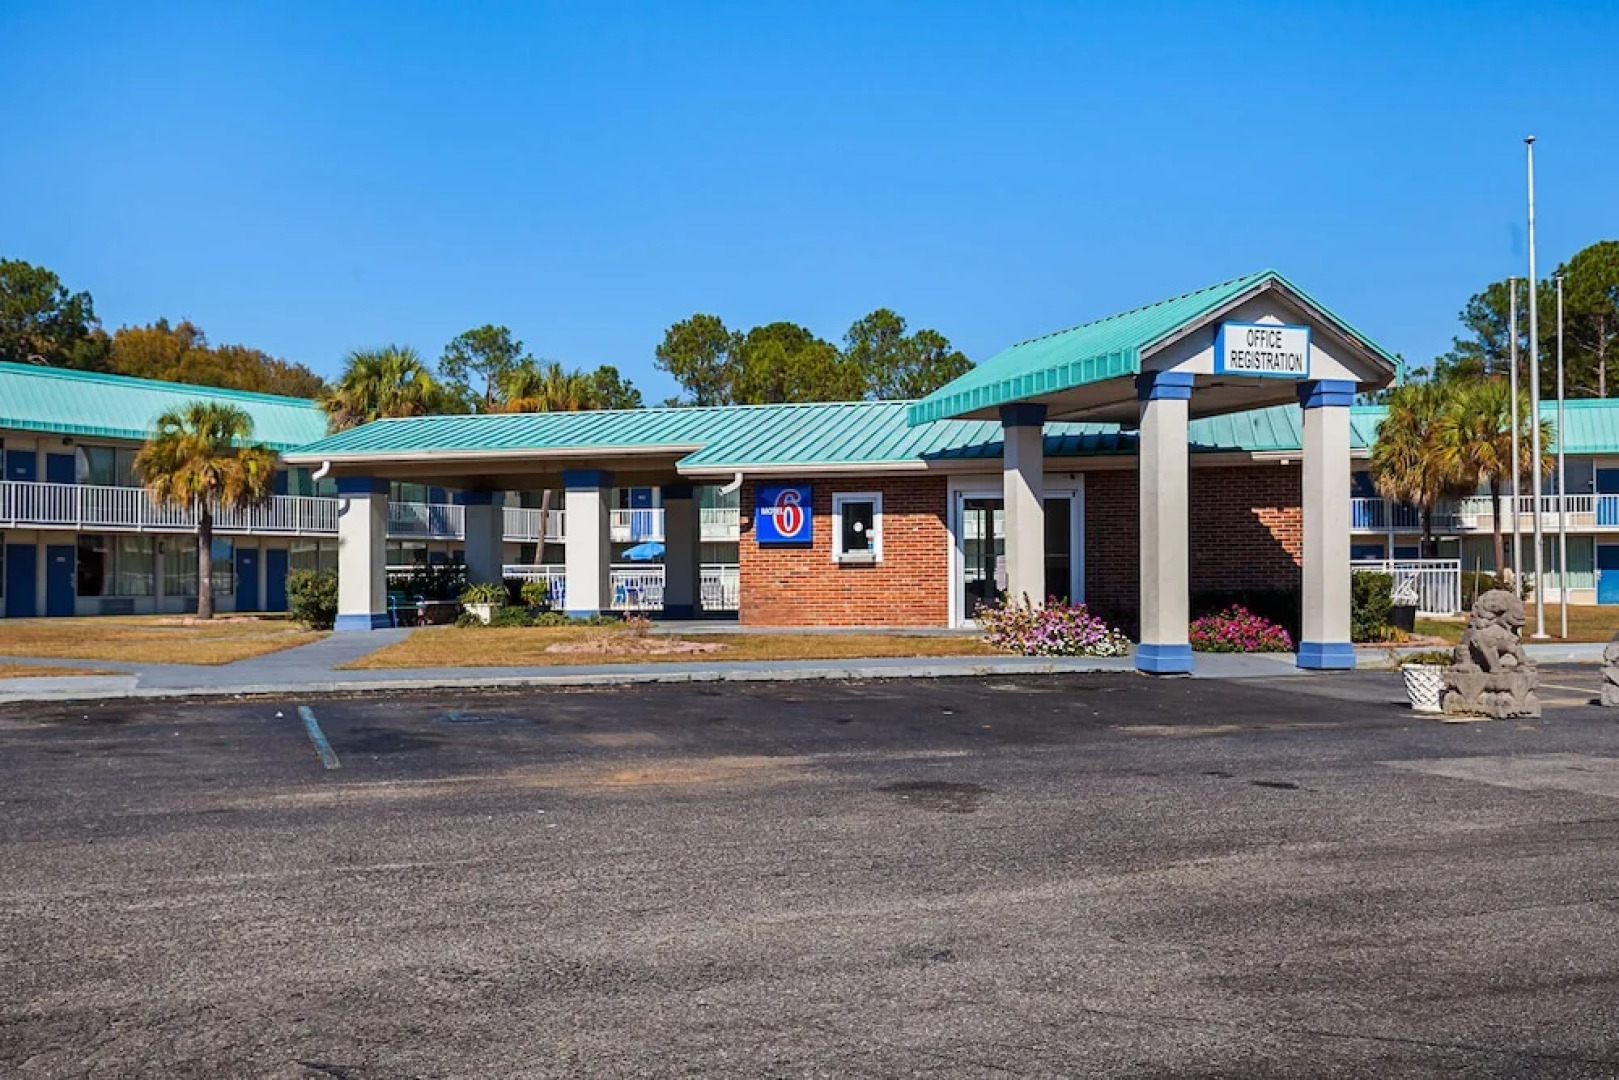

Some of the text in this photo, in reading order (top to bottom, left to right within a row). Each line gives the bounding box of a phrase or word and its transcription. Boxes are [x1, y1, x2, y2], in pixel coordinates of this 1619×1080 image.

[1246, 328, 1282, 349] OFFICE
[1230, 350, 1302, 371] REGISTRATION
[774, 488, 803, 537] 6
